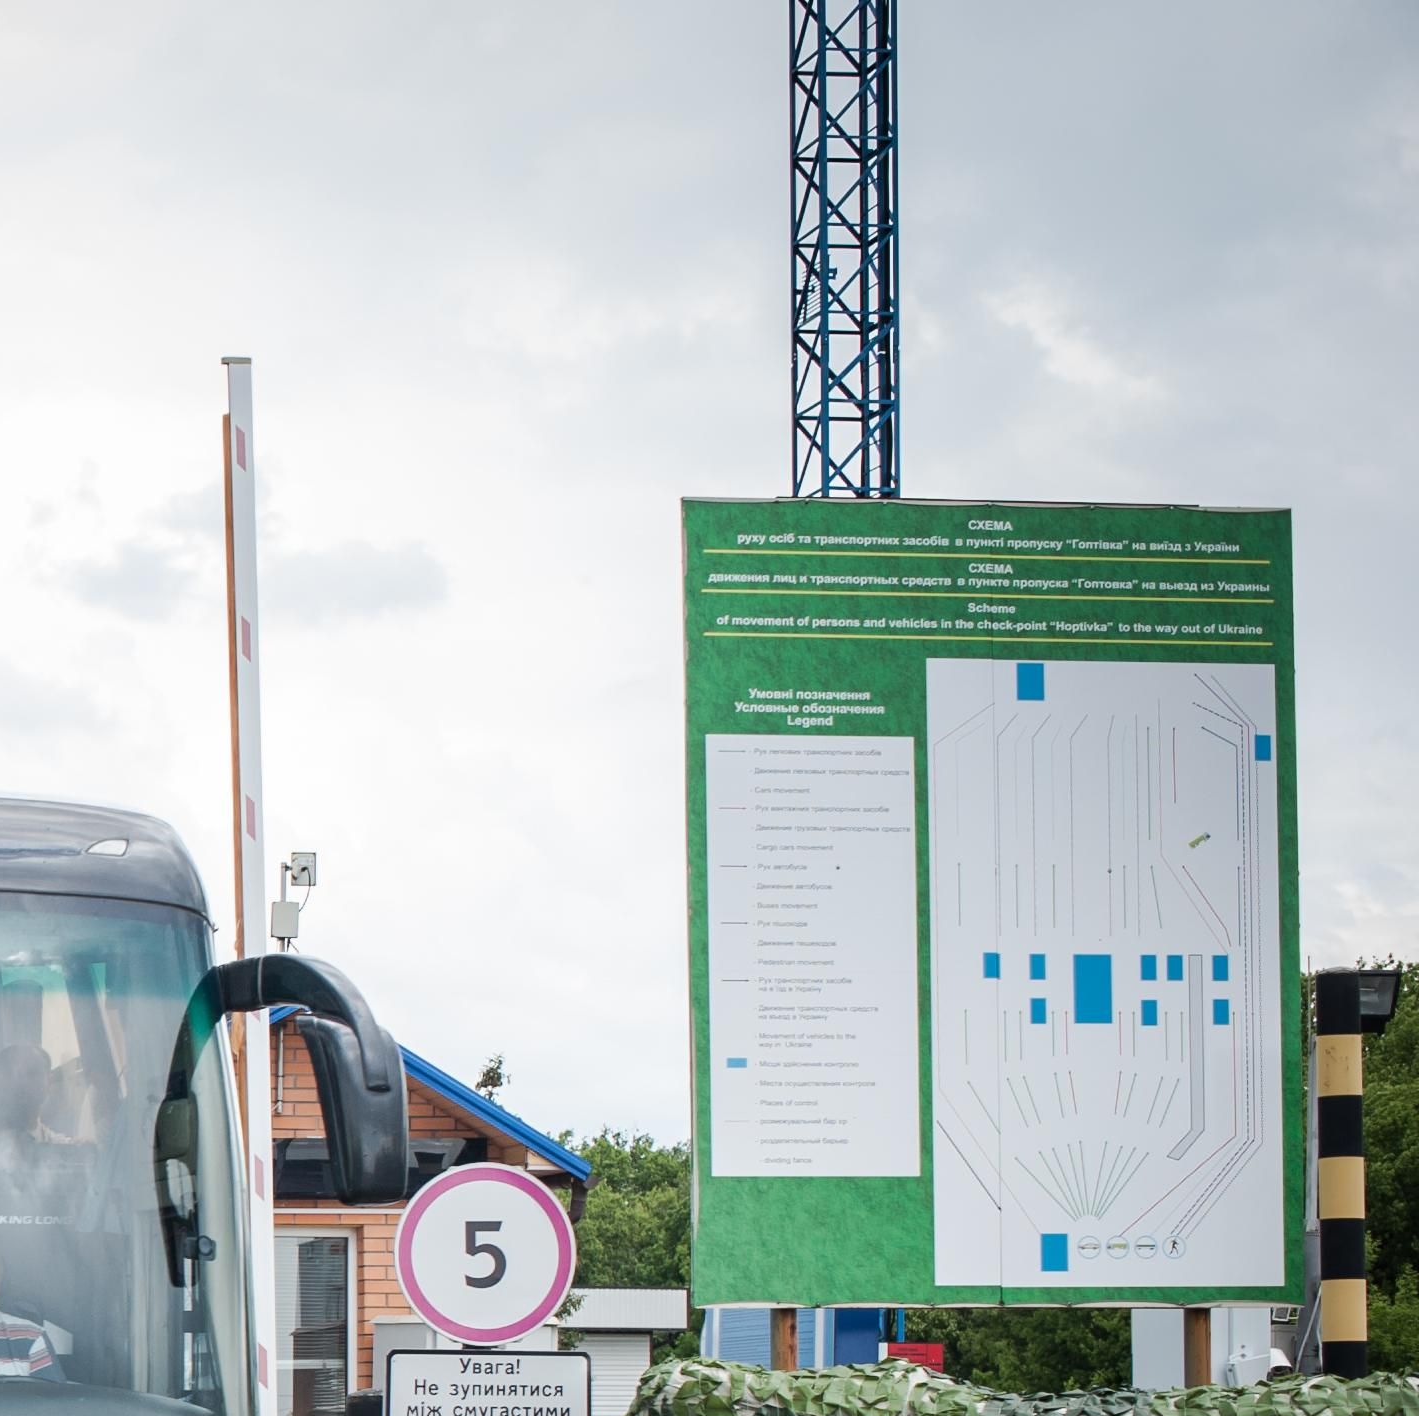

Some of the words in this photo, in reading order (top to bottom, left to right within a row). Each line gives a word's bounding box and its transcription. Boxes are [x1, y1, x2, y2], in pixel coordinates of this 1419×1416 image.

[968, 520, 1013, 531] СХЕМА
[737, 534, 765, 544] руху
[769, 533, 794, 543] осіб
[798, 535, 811, 544] та
[814, 535, 899, 547] транспортних
[903, 536, 949, 546] засобів
[967, 538, 1004, 548] пункті
[1007, 540, 1062, 551] пропуску
[1150, 542, 1181, 552] виїзд
[1194, 542, 1239, 553] України
[968, 563, 1013, 574] СХЕМА
[708, 573, 769, 583] движения
[773, 575, 796, 584] лиц
[800, 575, 807, 583] и
[810, 575, 898, 587] транспортных
[902, 576, 951, 587] средств
[969, 578, 1010, 588] пункте
[1013, 580, 1068, 589] пропуска
[1142, 582, 1155, 590] на
[1159, 582, 1197, 592] выезд
[1201, 583, 1214, 591] из
[1217, 581, 1270, 593] Украины
[968, 603, 1015, 613] Scheme
[717, 615, 729, 625] of
[732, 617, 794, 626] movement
[797, 616, 810, 626] of
[812, 618, 860, 629] persons
[863, 618, 885, 627] and
[889, 618, 937, 628] vehicles
[941, 619, 952, 628] in
[955, 619, 973, 629] the
[977, 620, 1046, 632] check-point
[1118, 623, 1130, 632] to
[1133, 623, 1151, 633] the
[1155, 625, 1178, 635] way
[1181, 624, 1200, 633] out
[1203, 624, 1215, 633] of
[1218, 624, 1263, 634] Ukraine
[749, 688, 793, 700] Умовні
[796, 691, 870, 701] позначення
[735, 701, 799, 714] Условные
[802, 703, 885, 714] обозначения
[787, 716, 833, 728] Legend
[35, 1215, 75, 1225] LONG
[464, 1220, 507, 1289] 5
[459, 1359, 521, 1377] Увага!
[414, 1380, 439, 1396] Не
[449, 1382, 563, 1401] зупинятися
